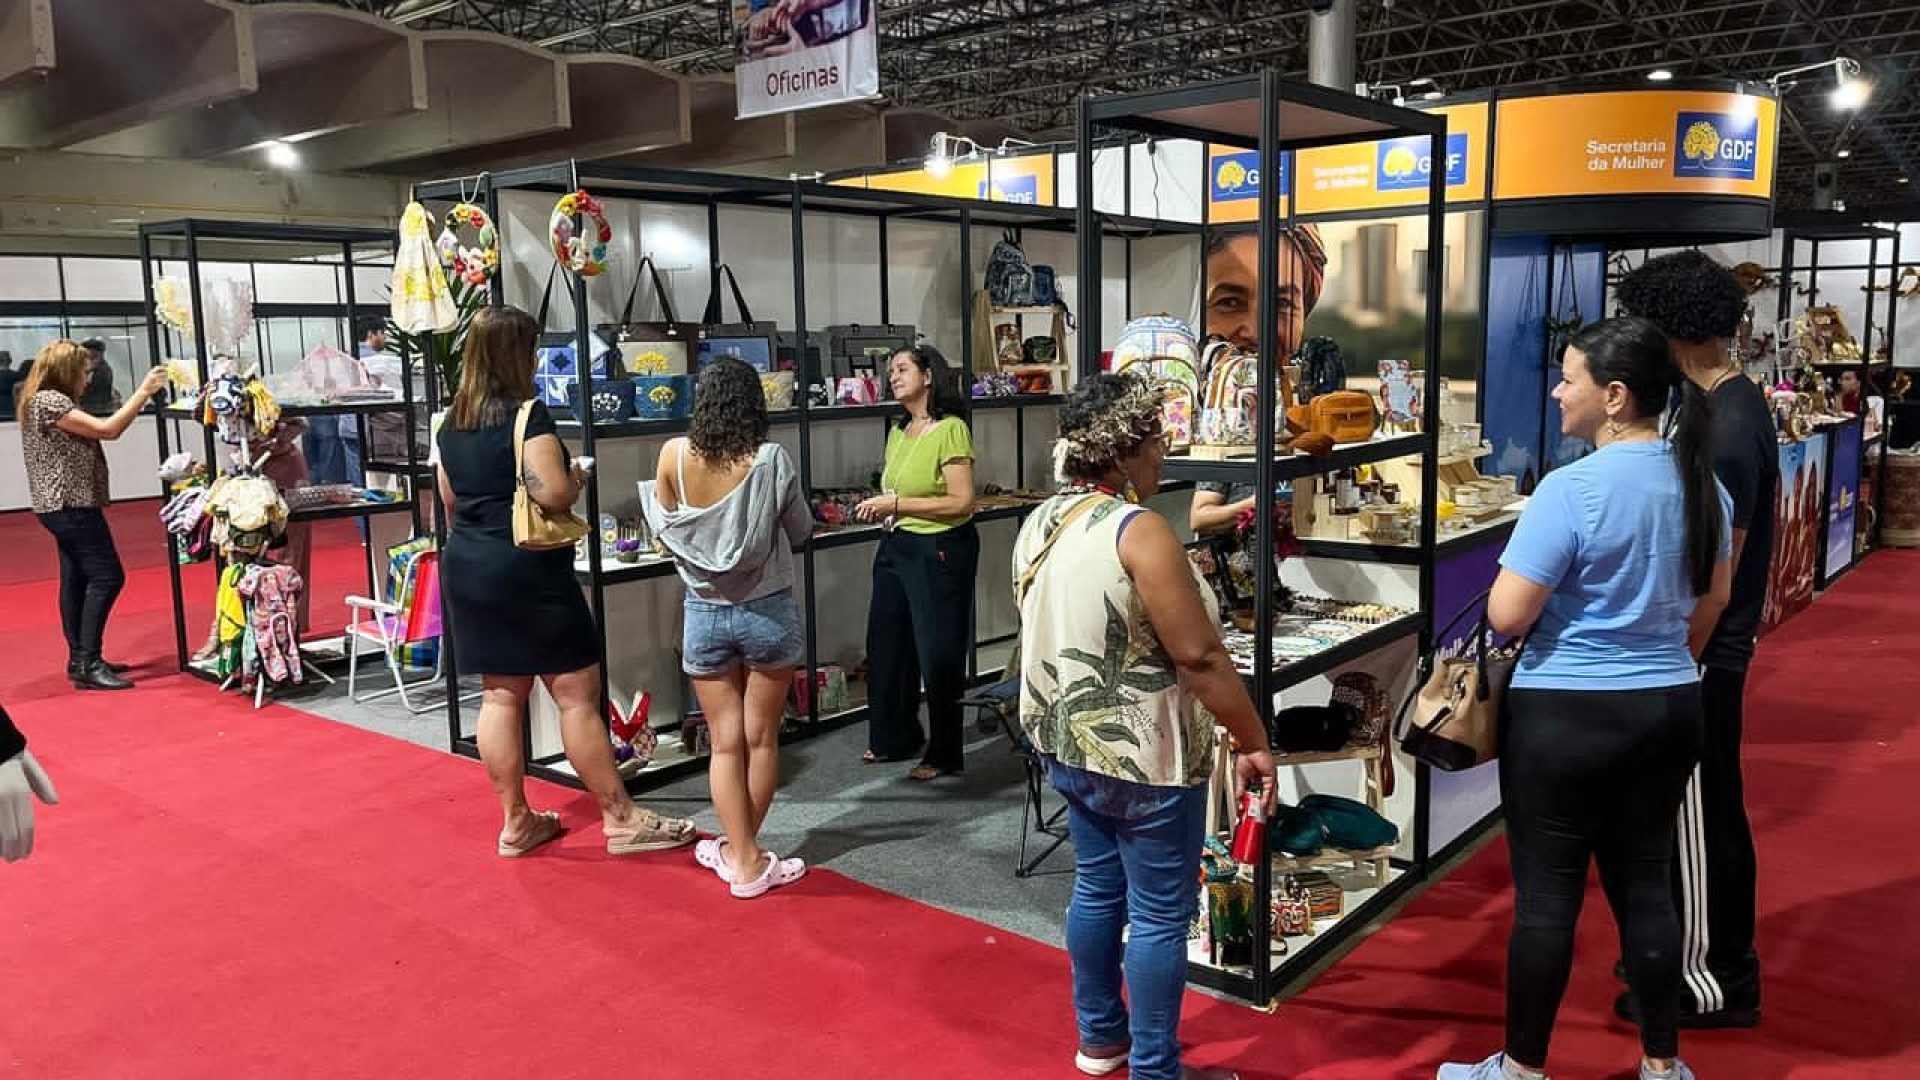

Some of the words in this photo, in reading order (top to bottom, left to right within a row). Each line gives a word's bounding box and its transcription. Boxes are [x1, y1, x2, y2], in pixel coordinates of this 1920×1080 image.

[766, 65, 839, 96] Oficinas
[1586, 139, 1666, 155] Secretaria
[1720, 138, 1753, 160] GDF
[1417, 153, 1461, 173] GF
[1587, 157, 1609, 171] da
[1613, 156, 1666, 170] Mulher
